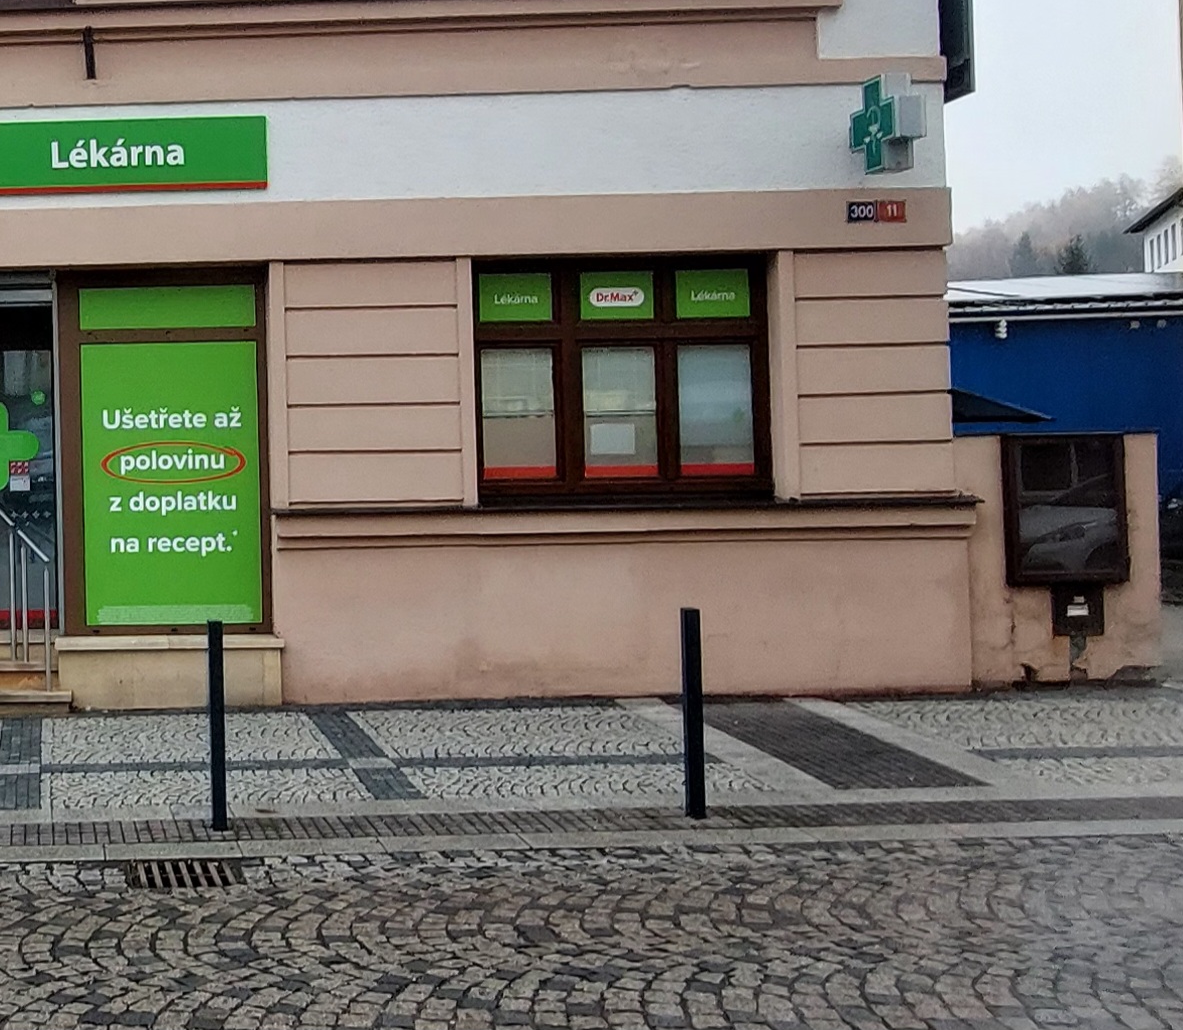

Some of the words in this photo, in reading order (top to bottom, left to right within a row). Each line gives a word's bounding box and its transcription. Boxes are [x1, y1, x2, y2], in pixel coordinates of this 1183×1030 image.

[50, 138, 186, 169] Lékárna
[850, 205, 874, 218] 300
[886, 204, 898, 217] 11
[493, 292, 539, 305] Lékárna
[102, 407, 207, 430] Ušetřete
[214, 406, 242, 429] až
[119, 448, 226, 475] polovinu
[109, 496, 122, 512] z
[129, 491, 237, 516] doplatku
[110, 536, 139, 554] na
